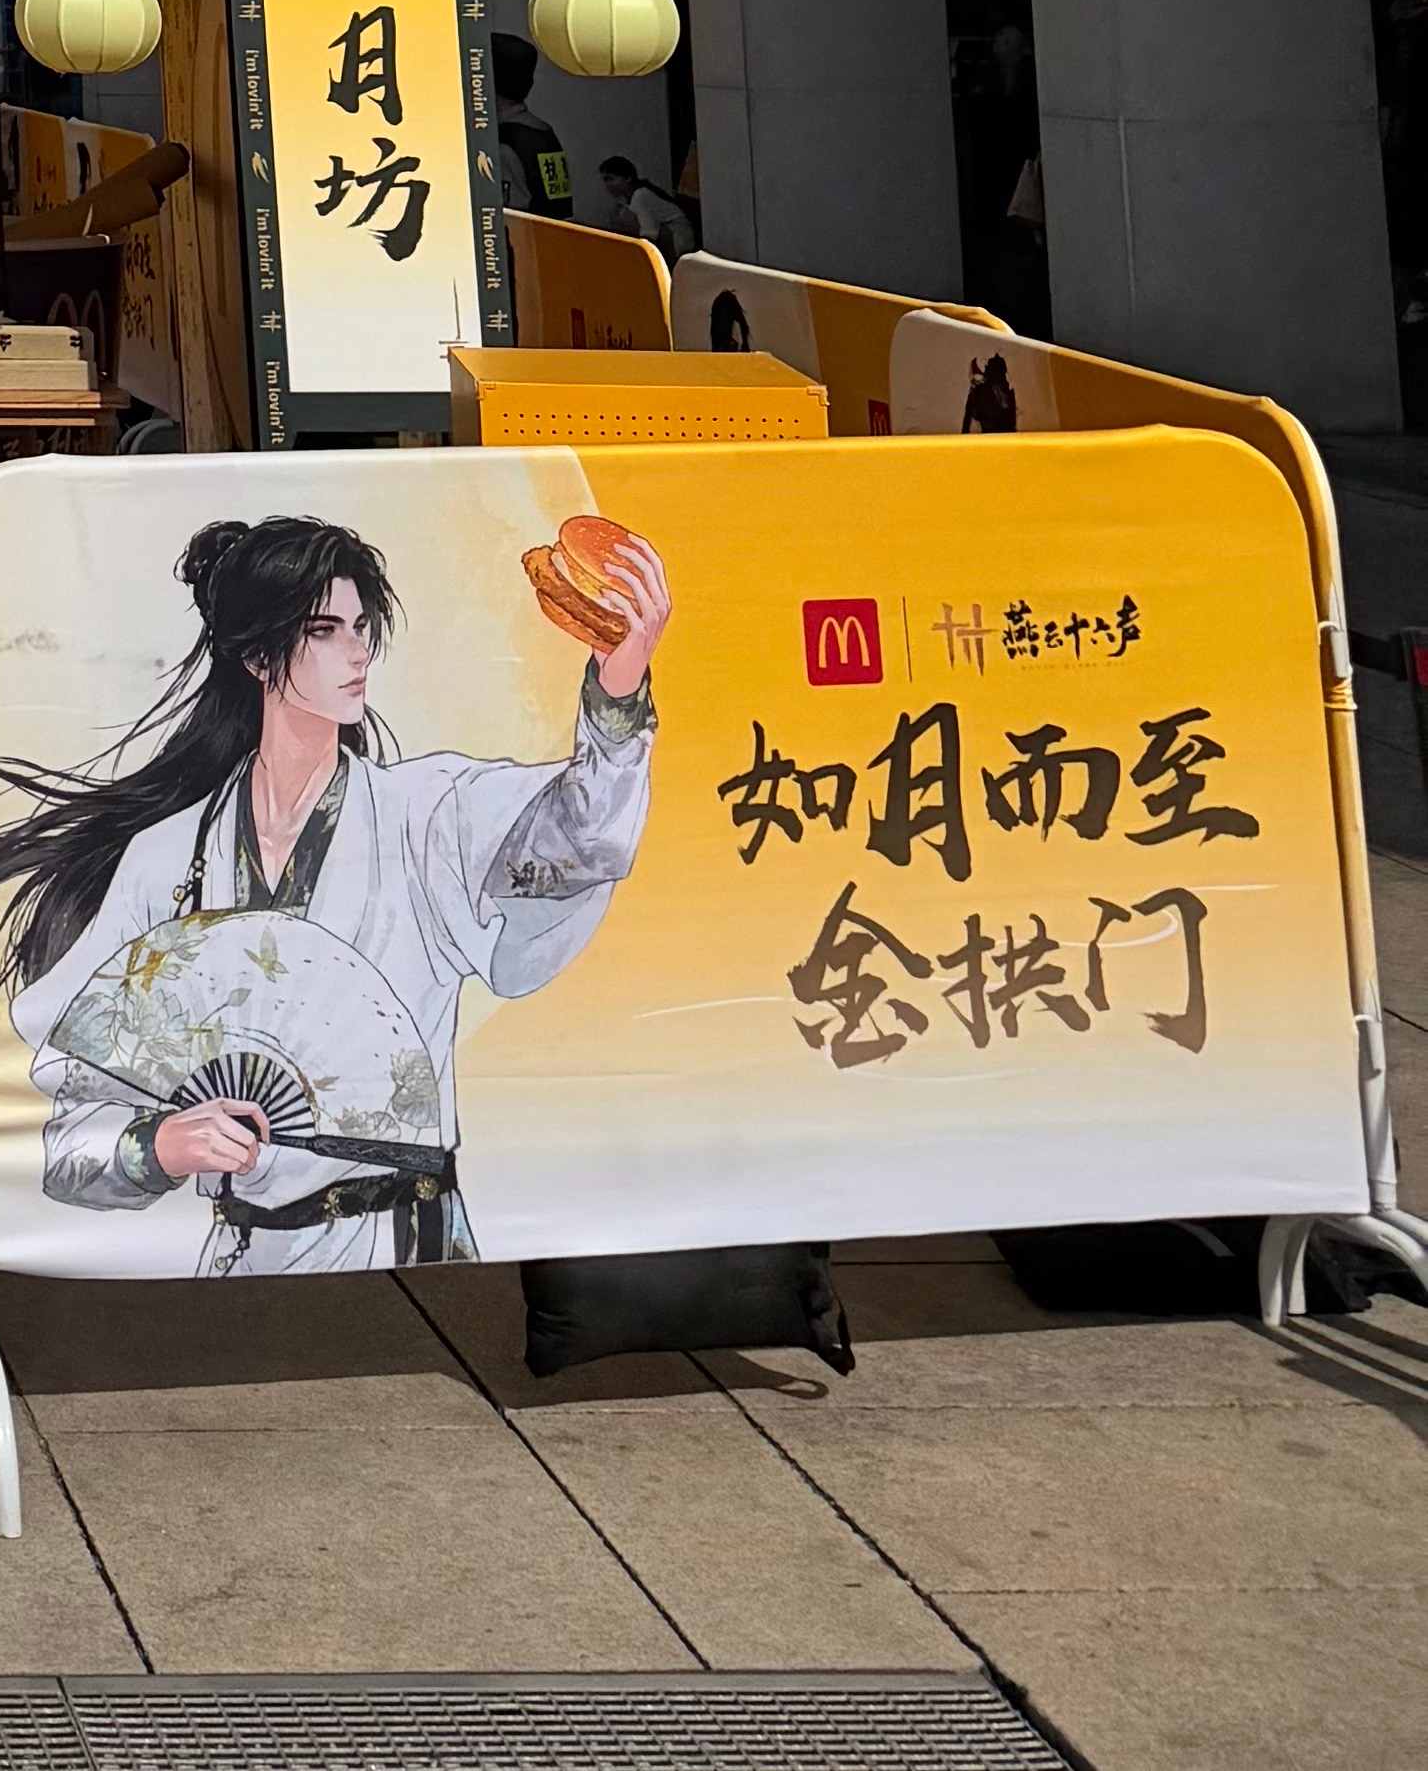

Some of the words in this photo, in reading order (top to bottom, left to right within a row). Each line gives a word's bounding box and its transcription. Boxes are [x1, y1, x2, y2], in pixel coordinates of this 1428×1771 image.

[1002, 594, 1141, 661] 燕云十六声
[717, 702, 1260, 882] 如月而至
[786, 881, 1208, 1069] 金拱门
